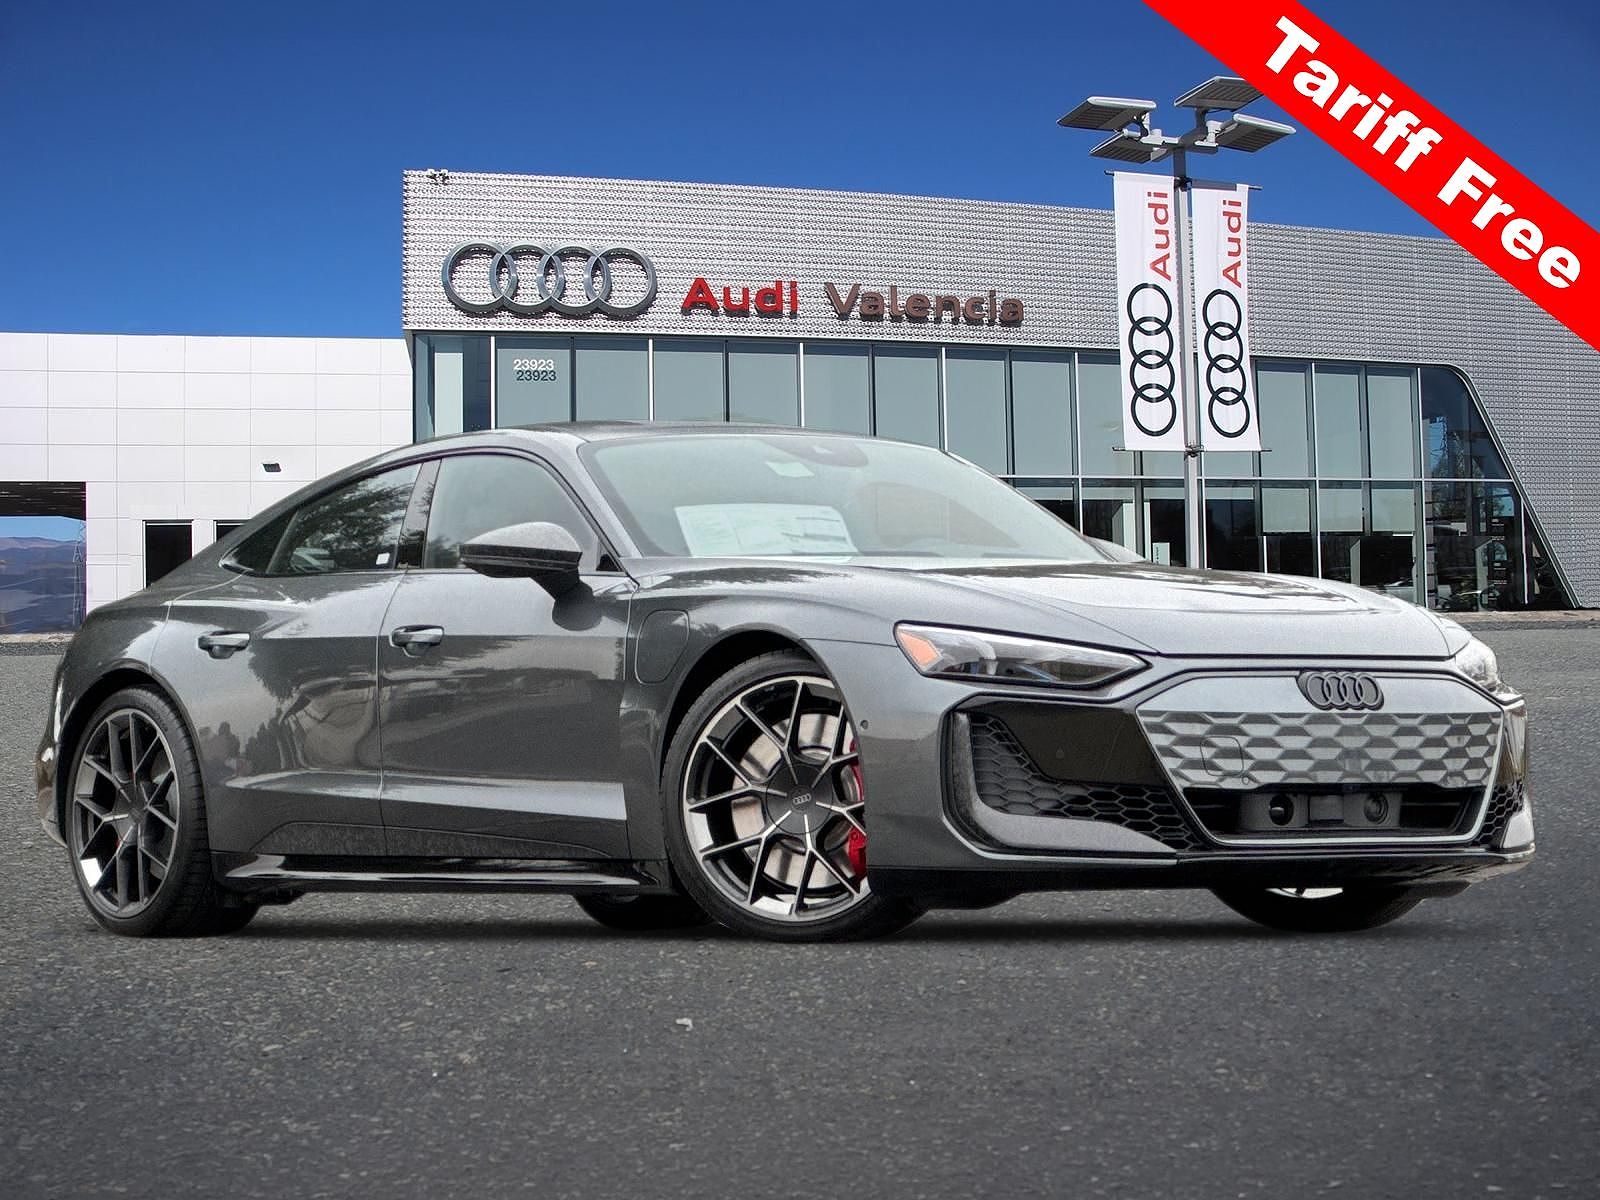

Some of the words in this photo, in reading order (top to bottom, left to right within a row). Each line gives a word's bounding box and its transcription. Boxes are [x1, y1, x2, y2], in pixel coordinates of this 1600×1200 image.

[1147, 191, 1172, 281] Audi
[1222, 199, 1242, 288] Audi
[680, 277, 799, 317] Audi
[823, 282, 1025, 326] Valencia
[513, 358, 554, 371] 23923
[516, 369, 557, 381] 23923
